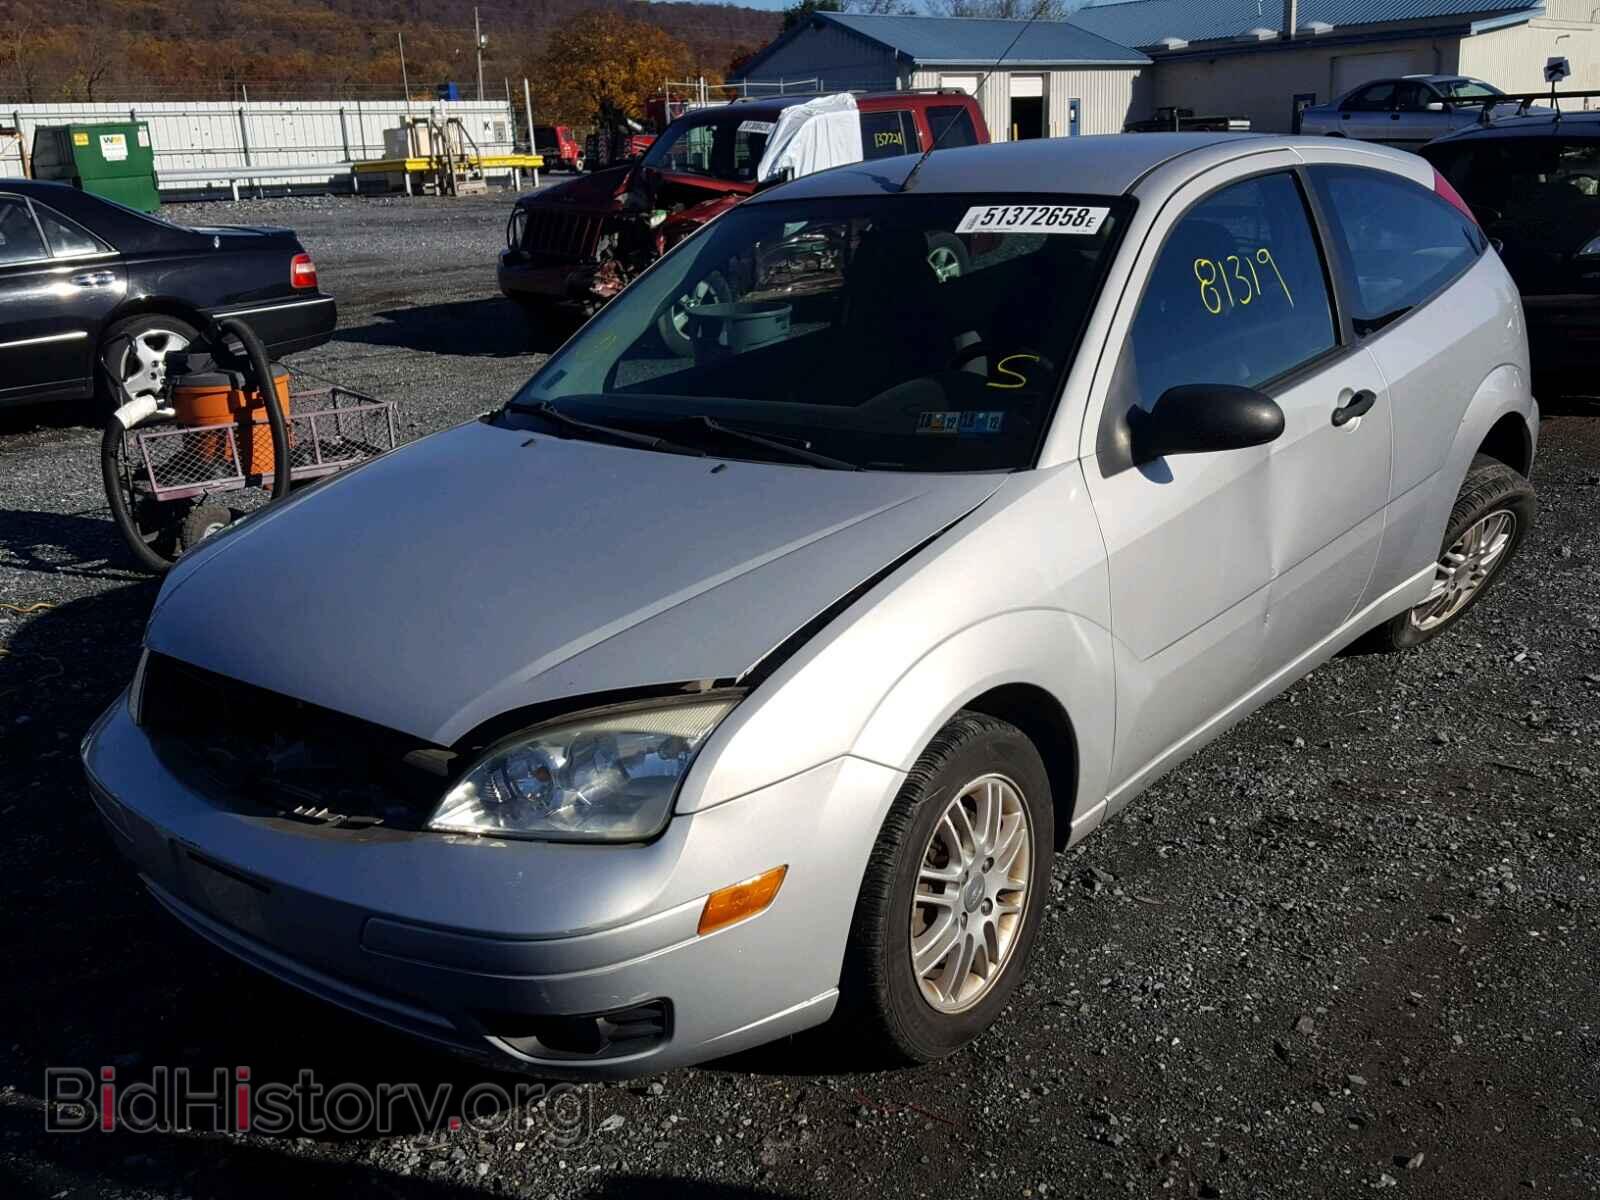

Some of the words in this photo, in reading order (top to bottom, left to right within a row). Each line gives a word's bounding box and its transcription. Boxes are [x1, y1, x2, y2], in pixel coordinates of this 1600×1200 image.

[483, 121, 491, 131] K
[1193, 247, 1295, 314] 81319
[985, 353, 1041, 389] S
